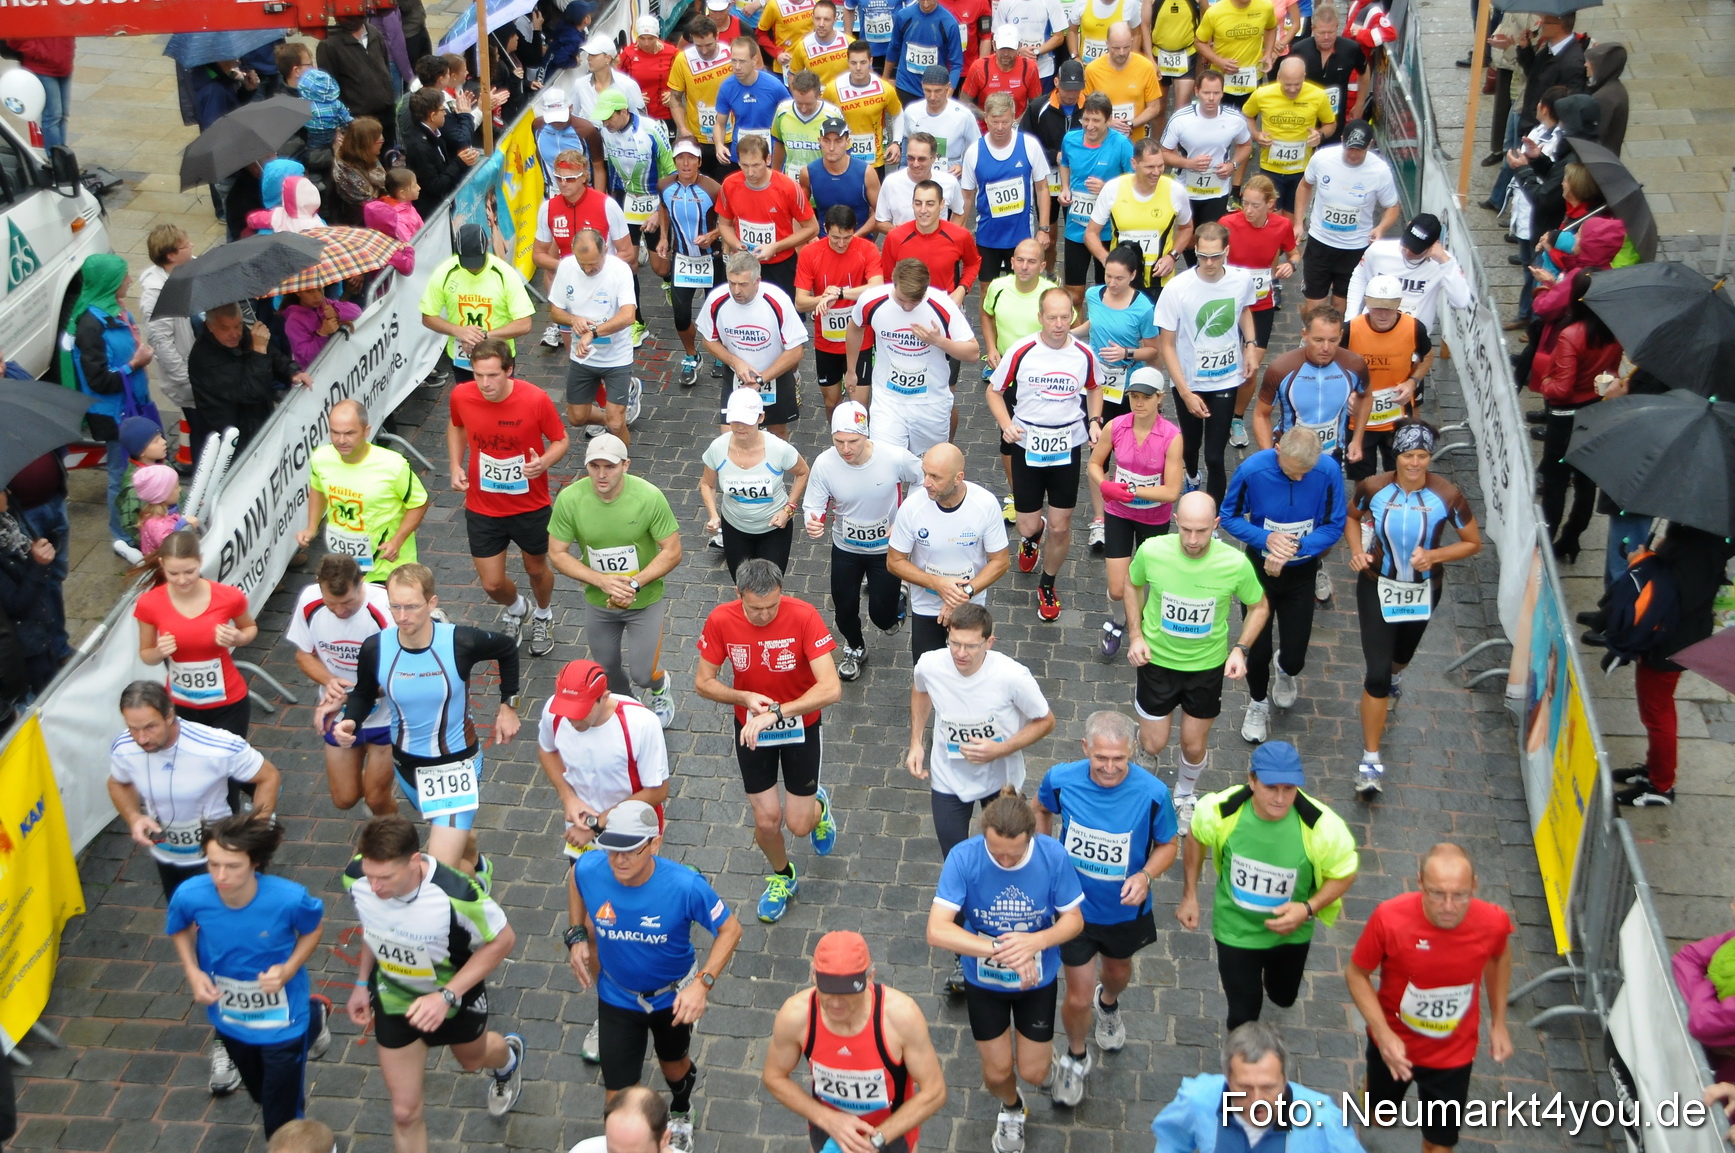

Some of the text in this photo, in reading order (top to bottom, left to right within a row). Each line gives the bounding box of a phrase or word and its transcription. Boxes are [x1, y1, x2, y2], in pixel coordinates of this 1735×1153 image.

[801, 12, 814, 21] BÖG
[866, 23, 891, 34] 2136
[809, 52, 848, 68] MAX BÖG
[908, 52, 935, 65] 3133
[1163, 54, 1181, 66] 438
[693, 65, 734, 85] MAX BÖG
[1231, 75, 1250, 86] 447
[841, 96, 886, 112] MAX BÖGL
[851, 142, 872, 153] 854
[1276, 149, 1298, 160] 443
[1196, 176, 1211, 188] 47
[994, 187, 1019, 204] 309
[631, 201, 653, 213] 556
[998, 203, 1020, 213] Winfried
[1073, 200, 1094, 215] 270
[1325, 210, 1357, 225] 2936
[742, 229, 772, 245] 2048
[679, 260, 710, 275] 2192
[458, 293, 493, 304] Müller
[466, 312, 484, 329] M
[724, 327, 761, 336] GERHART
[1201, 350, 1235, 369] 2748
[890, 370, 926, 388] 2929
[1028, 376, 1070, 386] GERHART
[1046, 383, 1076, 392] JANIG
[1030, 436, 1069, 453] 3025
[484, 464, 523, 482] 2573
[328, 484, 365, 500] Müller
[492, 482, 516, 492] Fabian
[728, 486, 769, 500] 3164
[339, 504, 356, 522] M
[218, 486, 269, 583] BMW
[846, 525, 887, 542] 2036
[329, 536, 368, 558] 2952
[602, 550, 628, 558] Neumarkt
[596, 556, 629, 573] 162
[1383, 585, 1425, 604] 2197
[1180, 599, 1208, 608] Neumarkt
[1165, 604, 1210, 624] 3047
[1172, 623, 1200, 634] Norbert
[338, 652, 361, 662] JAN
[172, 670, 219, 690] 2989
[758, 730, 792, 741] Reinhard
[948, 725, 996, 743] 2668
[424, 772, 472, 797] 3198
[166, 827, 204, 846] 988
[1069, 825, 1120, 845] PARTL Neumarkt
[1070, 836, 1123, 864] 2553
[1079, 859, 1109, 875] Ludwig
[1235, 868, 1288, 896] 3114
[973, 907, 992, 920] 13.
[608, 928, 668, 945] BARCLAYS
[378, 943, 418, 967] 448
[1, 930, 58, 1001] Gartenmauer
[386, 963, 413, 976] Oliver
[223, 989, 281, 1010] 2990
[1415, 998, 1458, 1020] 285
[820, 1076, 881, 1100] 2612
[832, 1099, 872, 1112] Manfred
